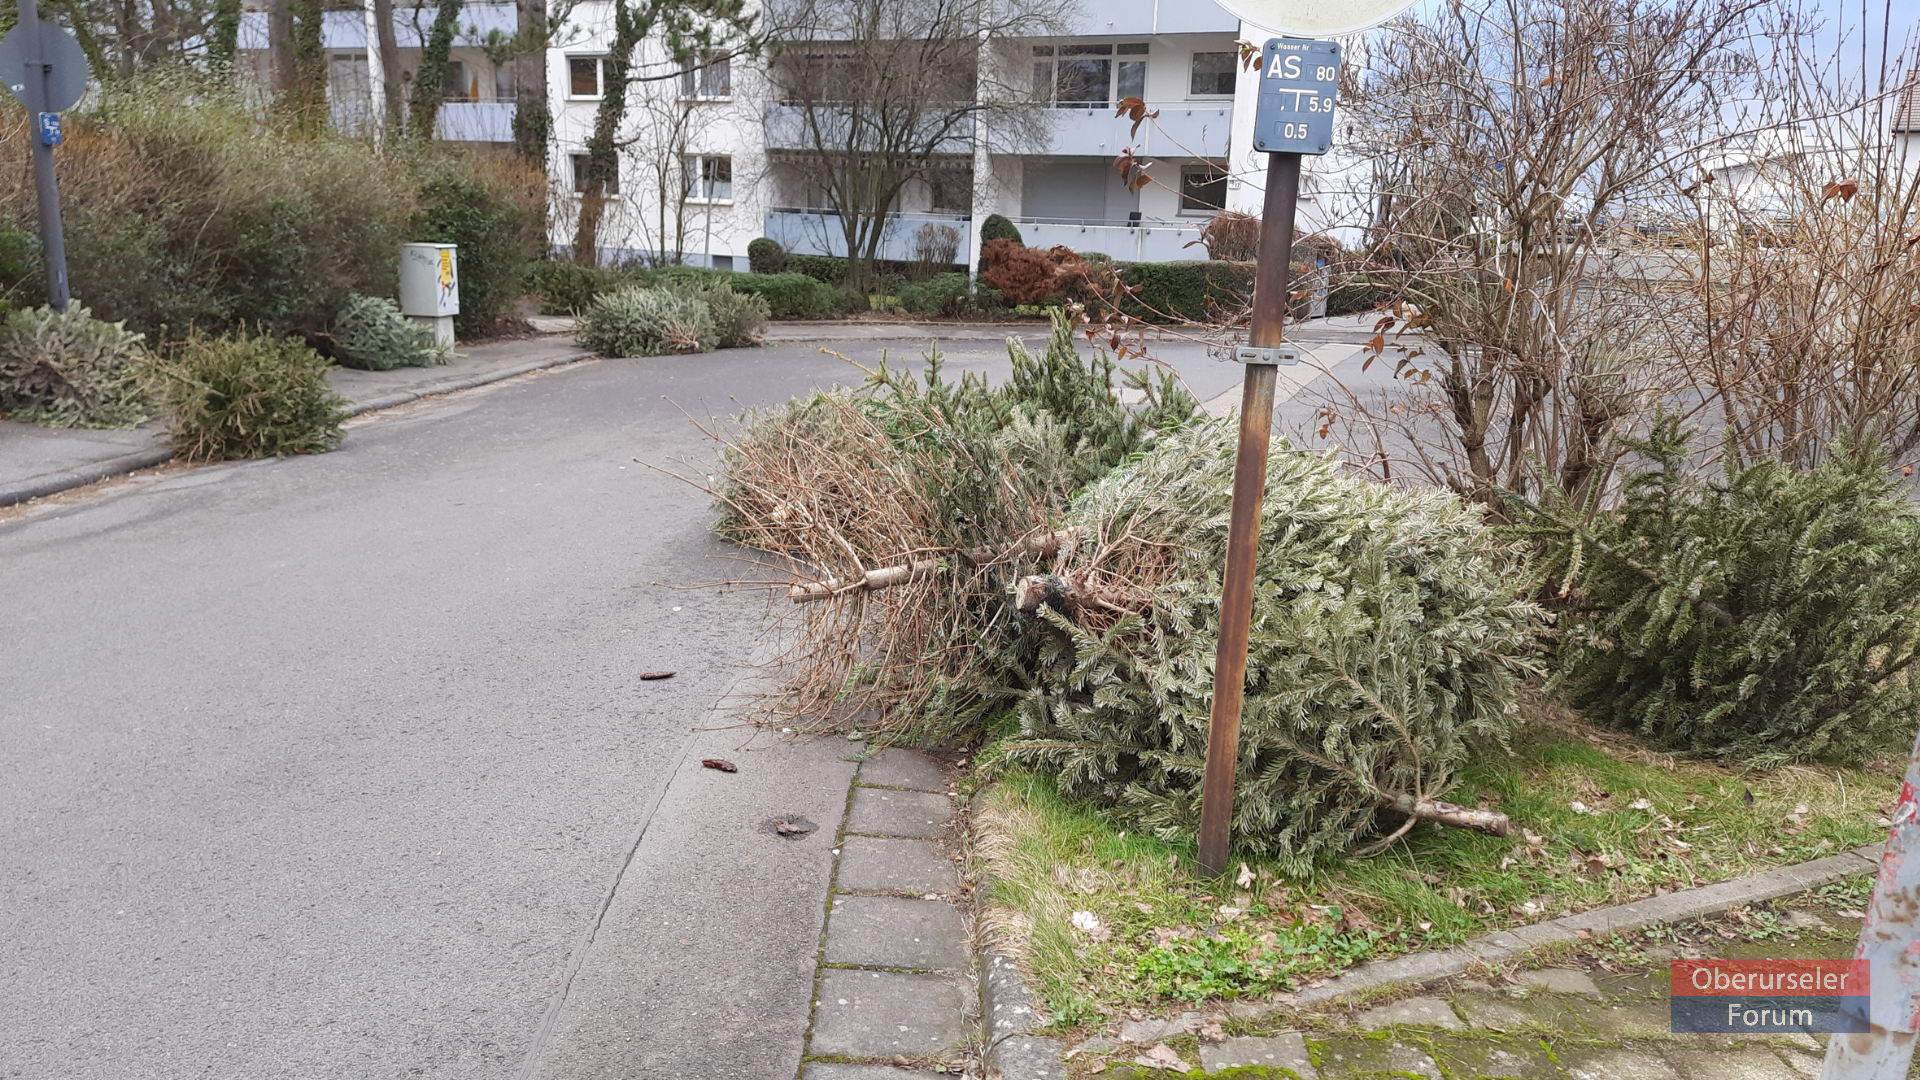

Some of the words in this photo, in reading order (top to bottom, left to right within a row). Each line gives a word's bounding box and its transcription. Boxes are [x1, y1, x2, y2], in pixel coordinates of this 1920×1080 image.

[1277, 42, 1300, 50] Wasser
[1266, 53, 1302, 79] AS
[1316, 65, 1336, 82] 80
[1309, 96, 1333, 113] 5,9
[1284, 123, 1308, 139] 0,5
